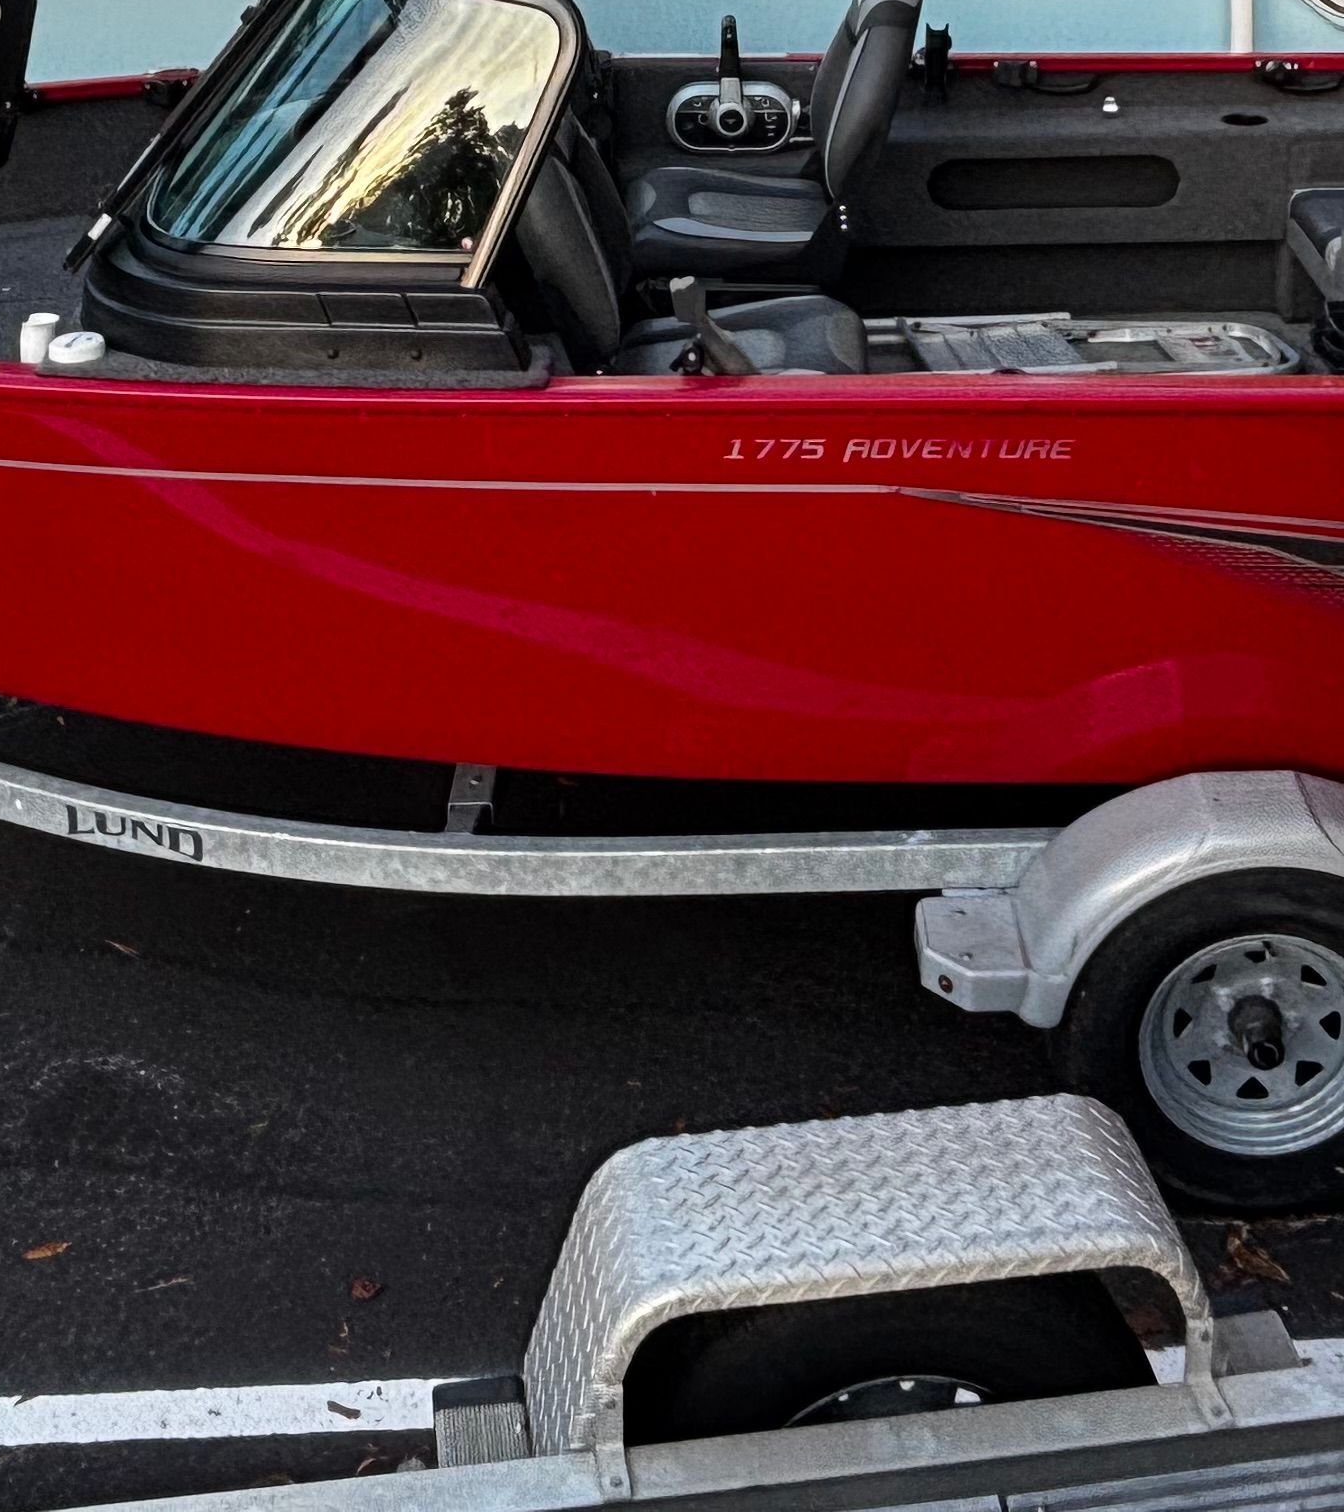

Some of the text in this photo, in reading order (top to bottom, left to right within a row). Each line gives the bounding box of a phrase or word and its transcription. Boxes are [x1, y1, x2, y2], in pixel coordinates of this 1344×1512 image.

[722, 438, 1077, 463] 1775 ADVENTURE
[66, 804, 204, 862] LUND
